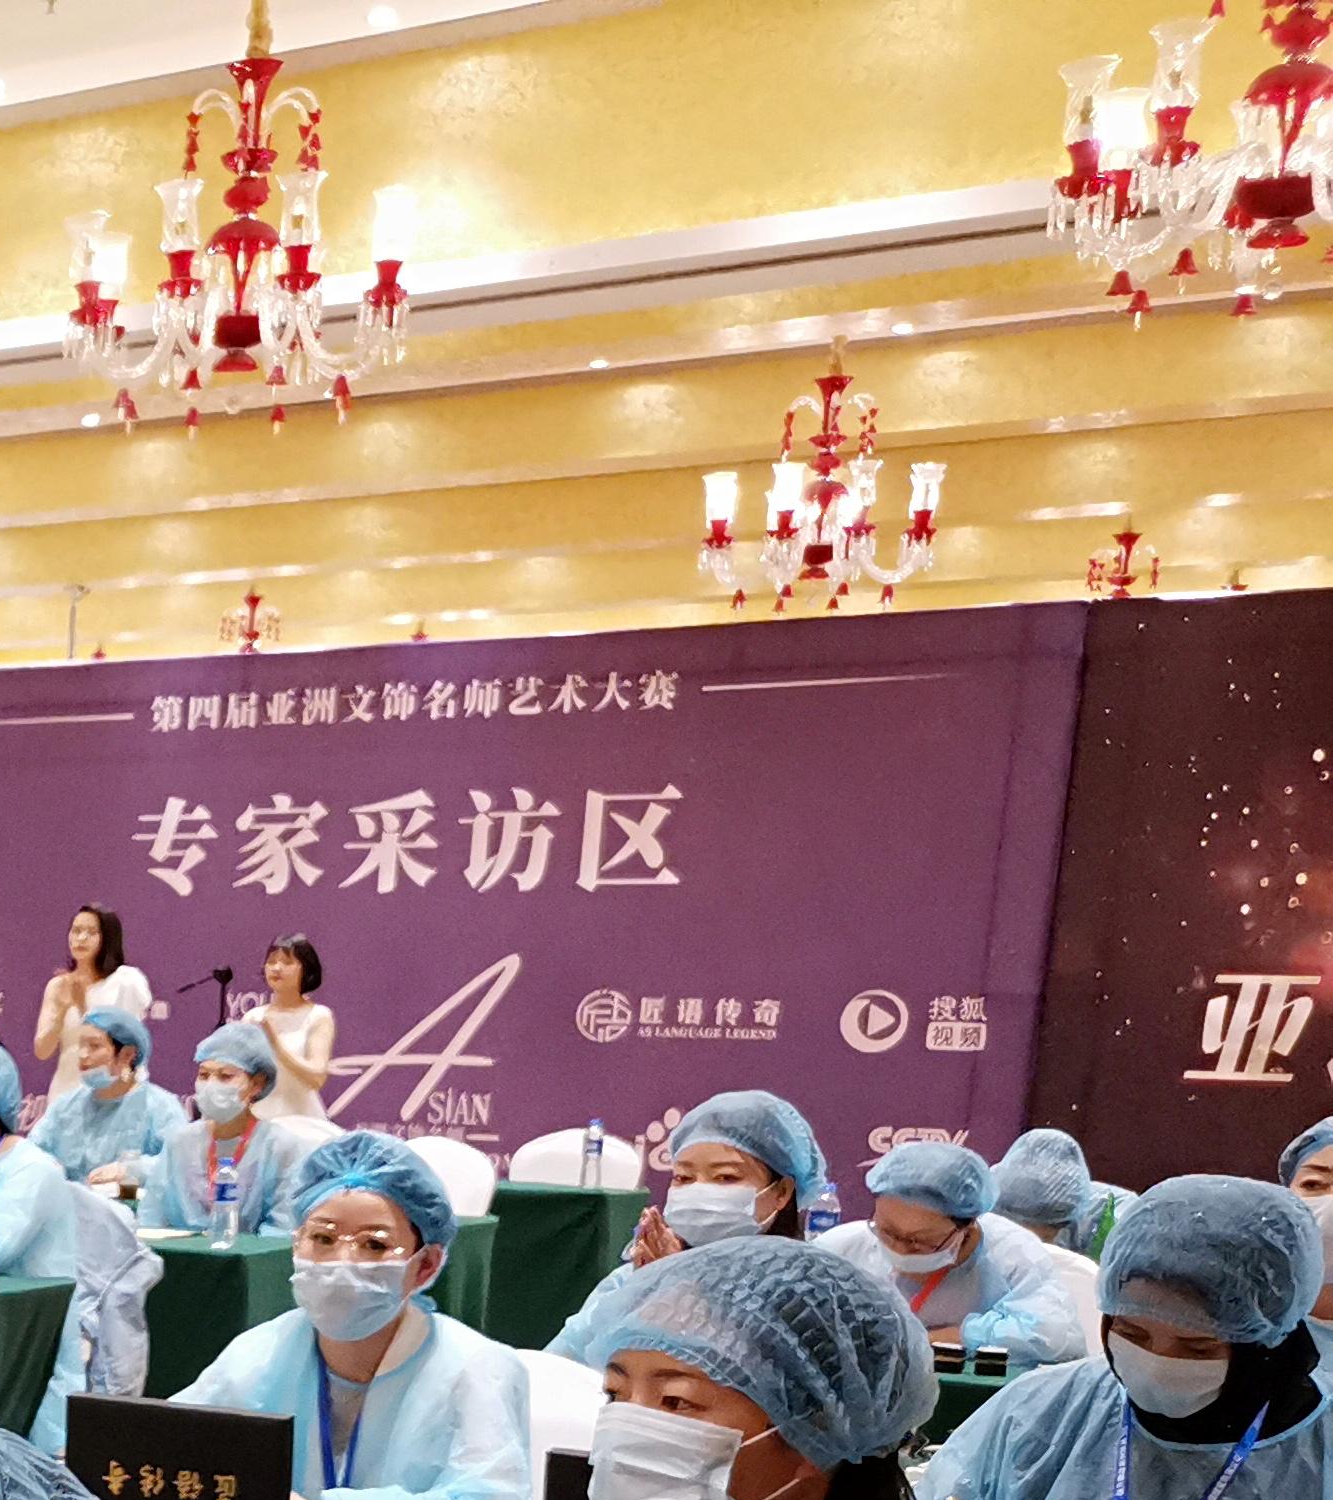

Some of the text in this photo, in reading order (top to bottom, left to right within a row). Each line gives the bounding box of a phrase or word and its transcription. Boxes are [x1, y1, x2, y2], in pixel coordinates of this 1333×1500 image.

[149, 669, 681, 732] 第四届亚洲文饰名师艺术大赛
[131, 784, 683, 896] 专家采访区
[639, 996, 782, 1026] 匠语传奇
[928, 996, 988, 1022] 搜狐
[1183, 974, 1322, 1082] 亚
[930, 1025, 986, 1049] 视频
